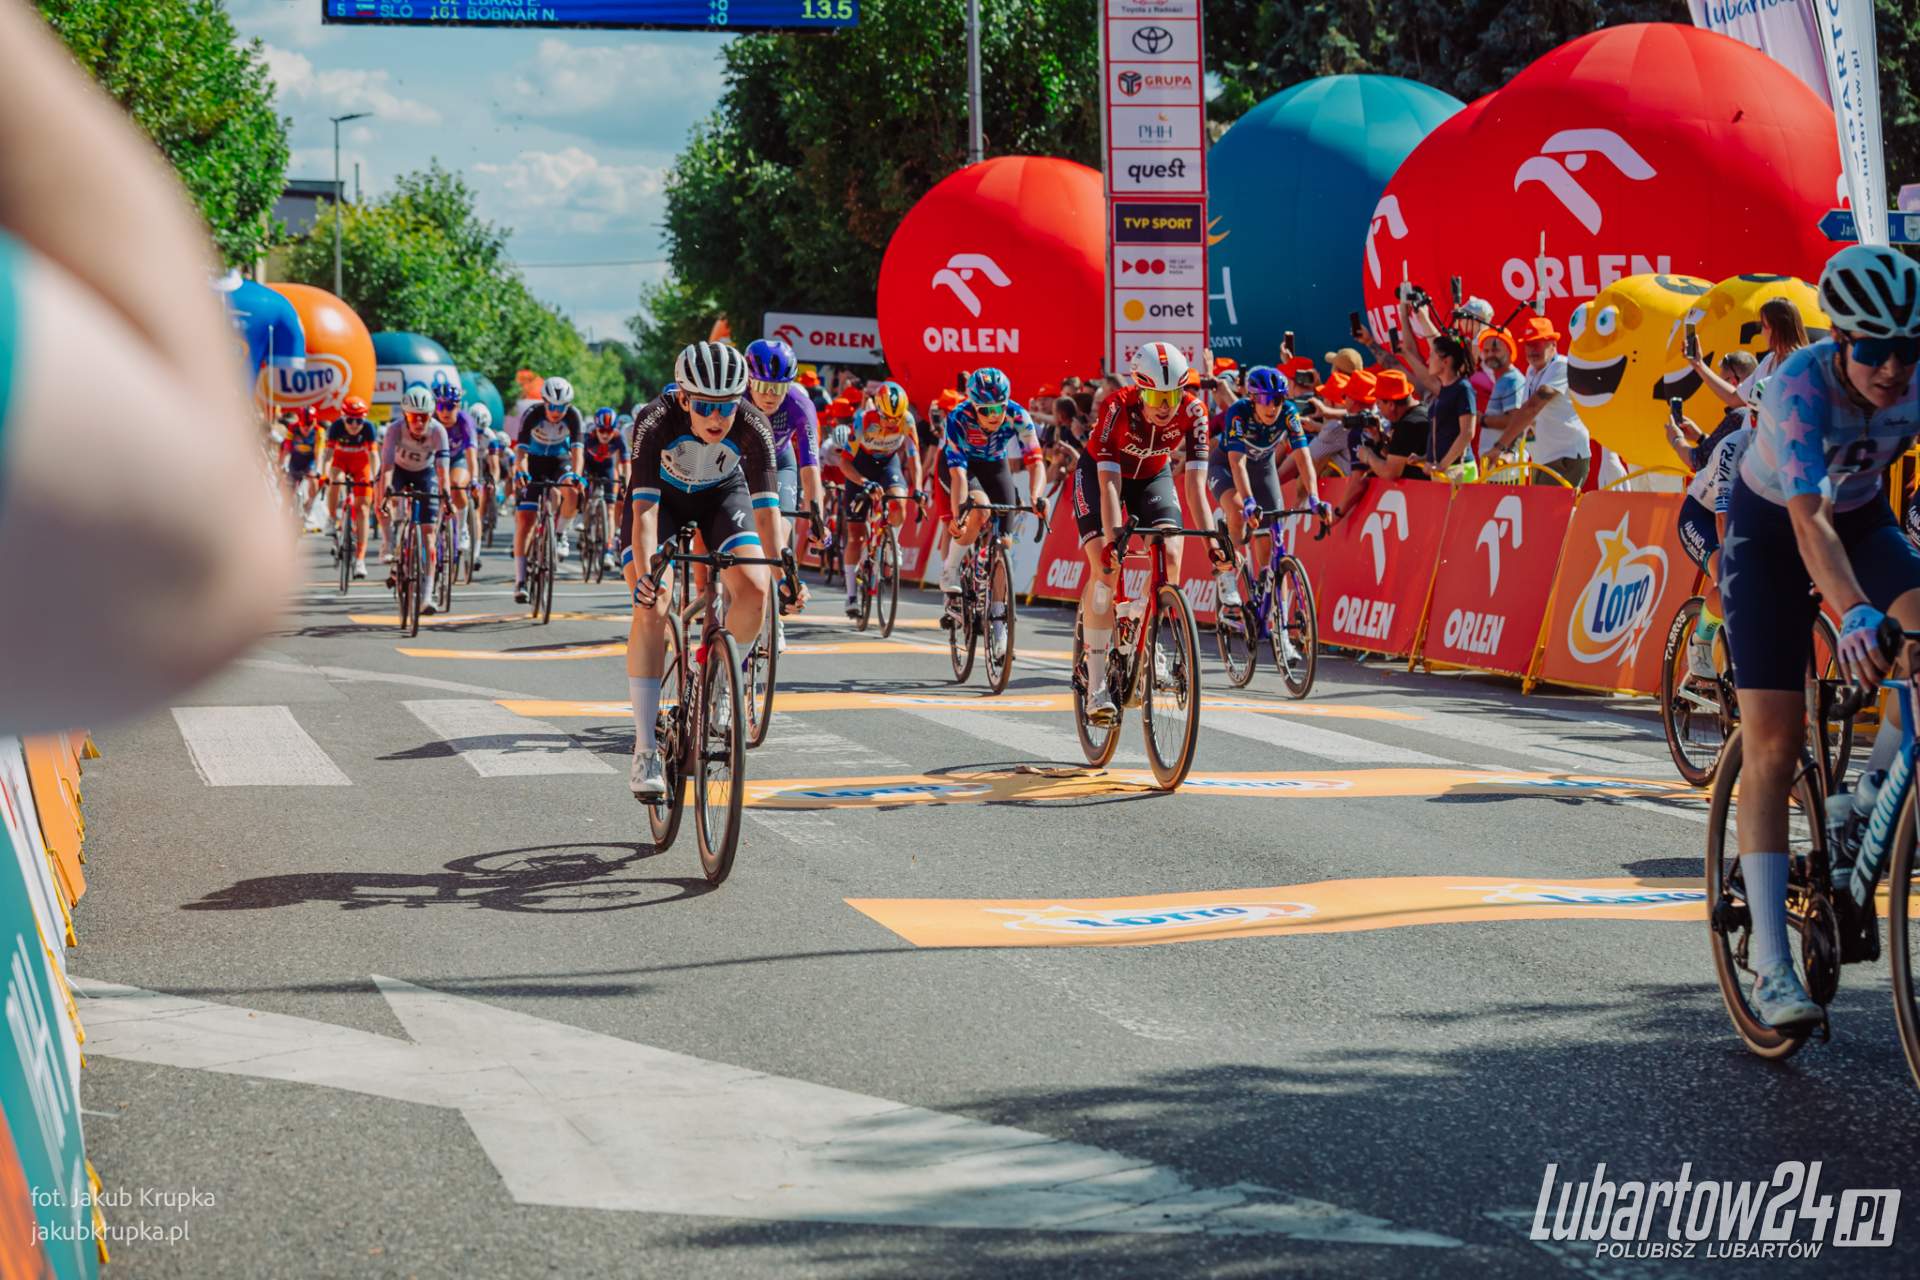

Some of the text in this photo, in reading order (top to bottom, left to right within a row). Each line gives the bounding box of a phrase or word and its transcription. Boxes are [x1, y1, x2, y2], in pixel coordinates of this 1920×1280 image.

[380, 5, 413, 18] SLO
[430, 6, 461, 20] 161
[1144, 75, 1192, 86] GRUPA
[1127, 157, 1186, 183] quest
[1123, 217, 1193, 229] TVP SPORT
[1149, 302, 1194, 318] onet
[809, 331, 876, 349] ORLEN
[922, 326, 1020, 354] ORLEN
[279, 367, 334, 394] LOTTO
[1592, 574, 1651, 635] LOTTO
[1332, 594, 1397, 641] ORLEN
[1443, 607, 1506, 656] ORLEN
[1066, 906, 1249, 928] LOTTO
